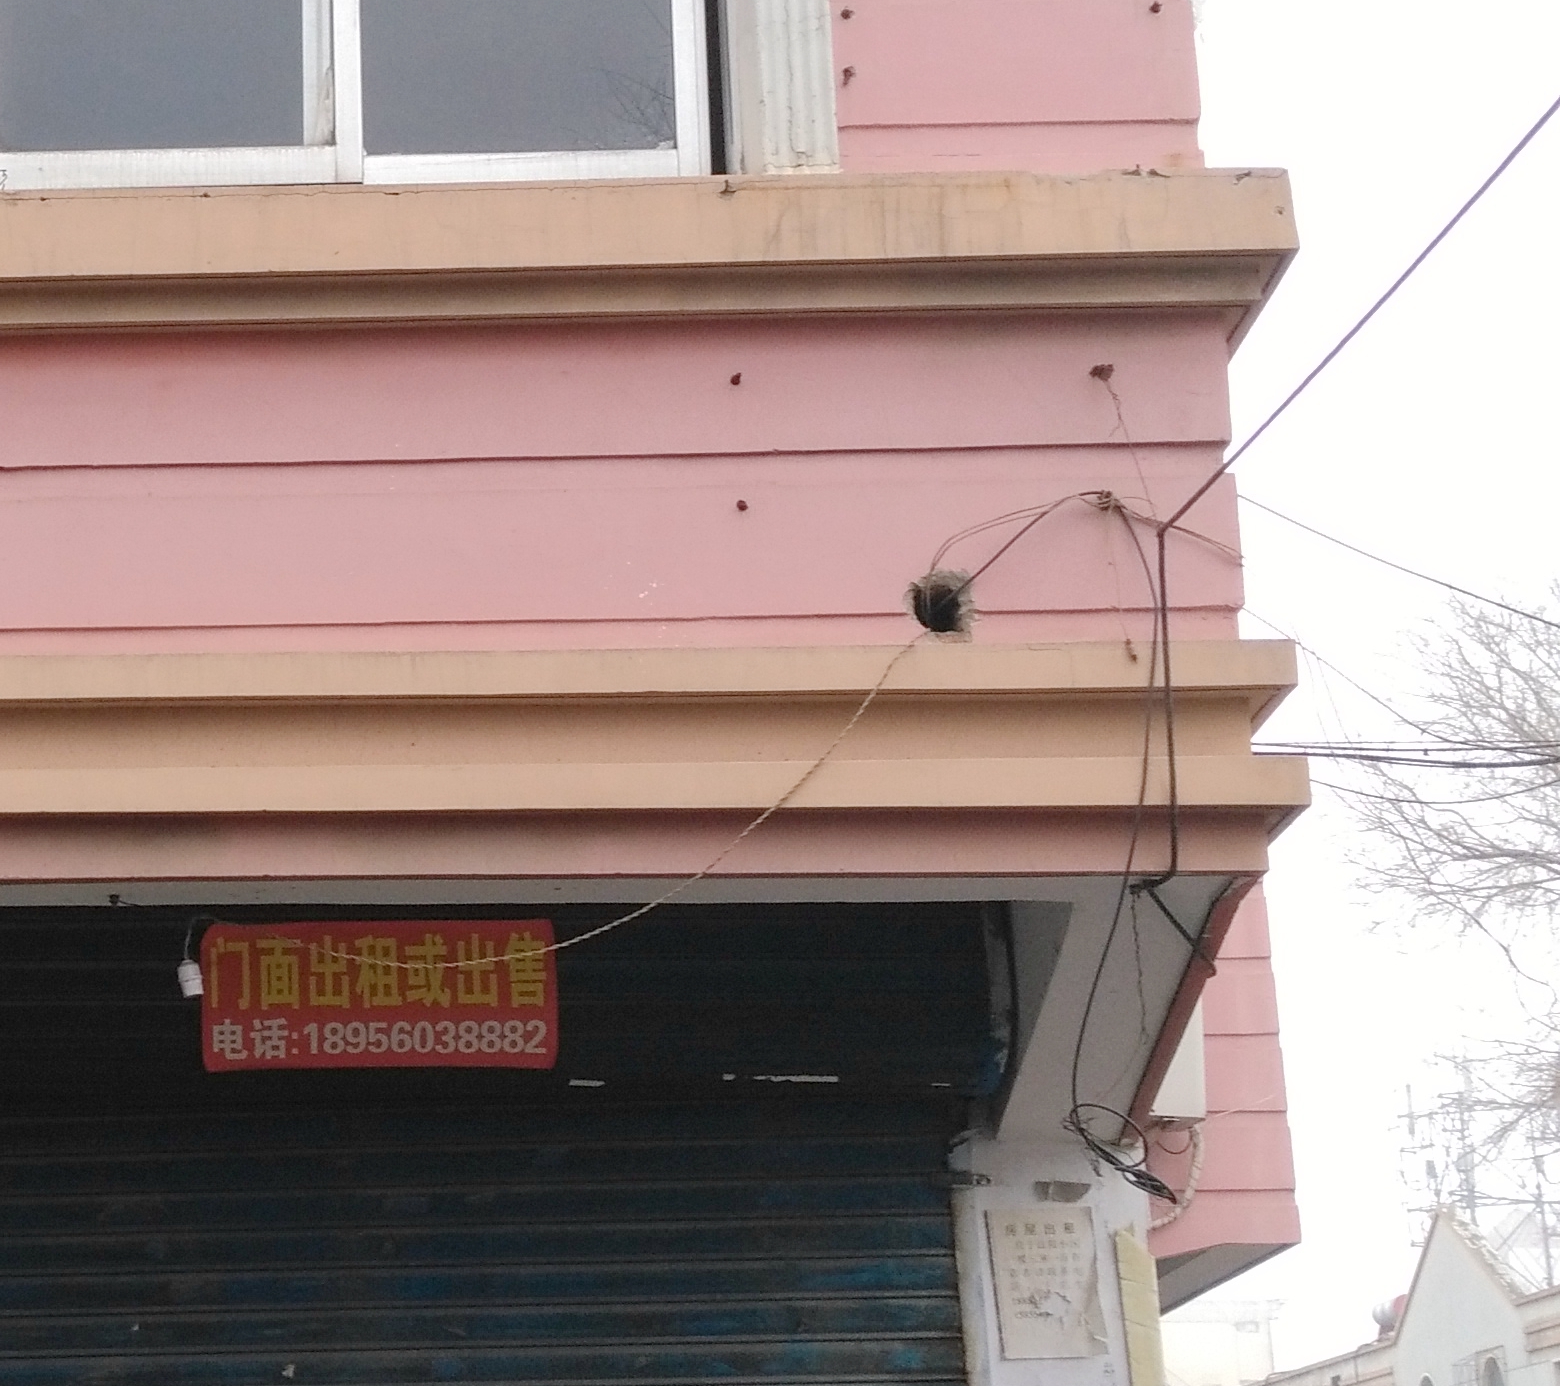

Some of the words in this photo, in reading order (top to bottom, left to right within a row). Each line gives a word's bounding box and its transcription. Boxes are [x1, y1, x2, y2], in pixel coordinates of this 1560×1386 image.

[209, 931, 547, 1010] 门面出租或出售
[212, 1018, 547, 1059] 电话:18956038882
